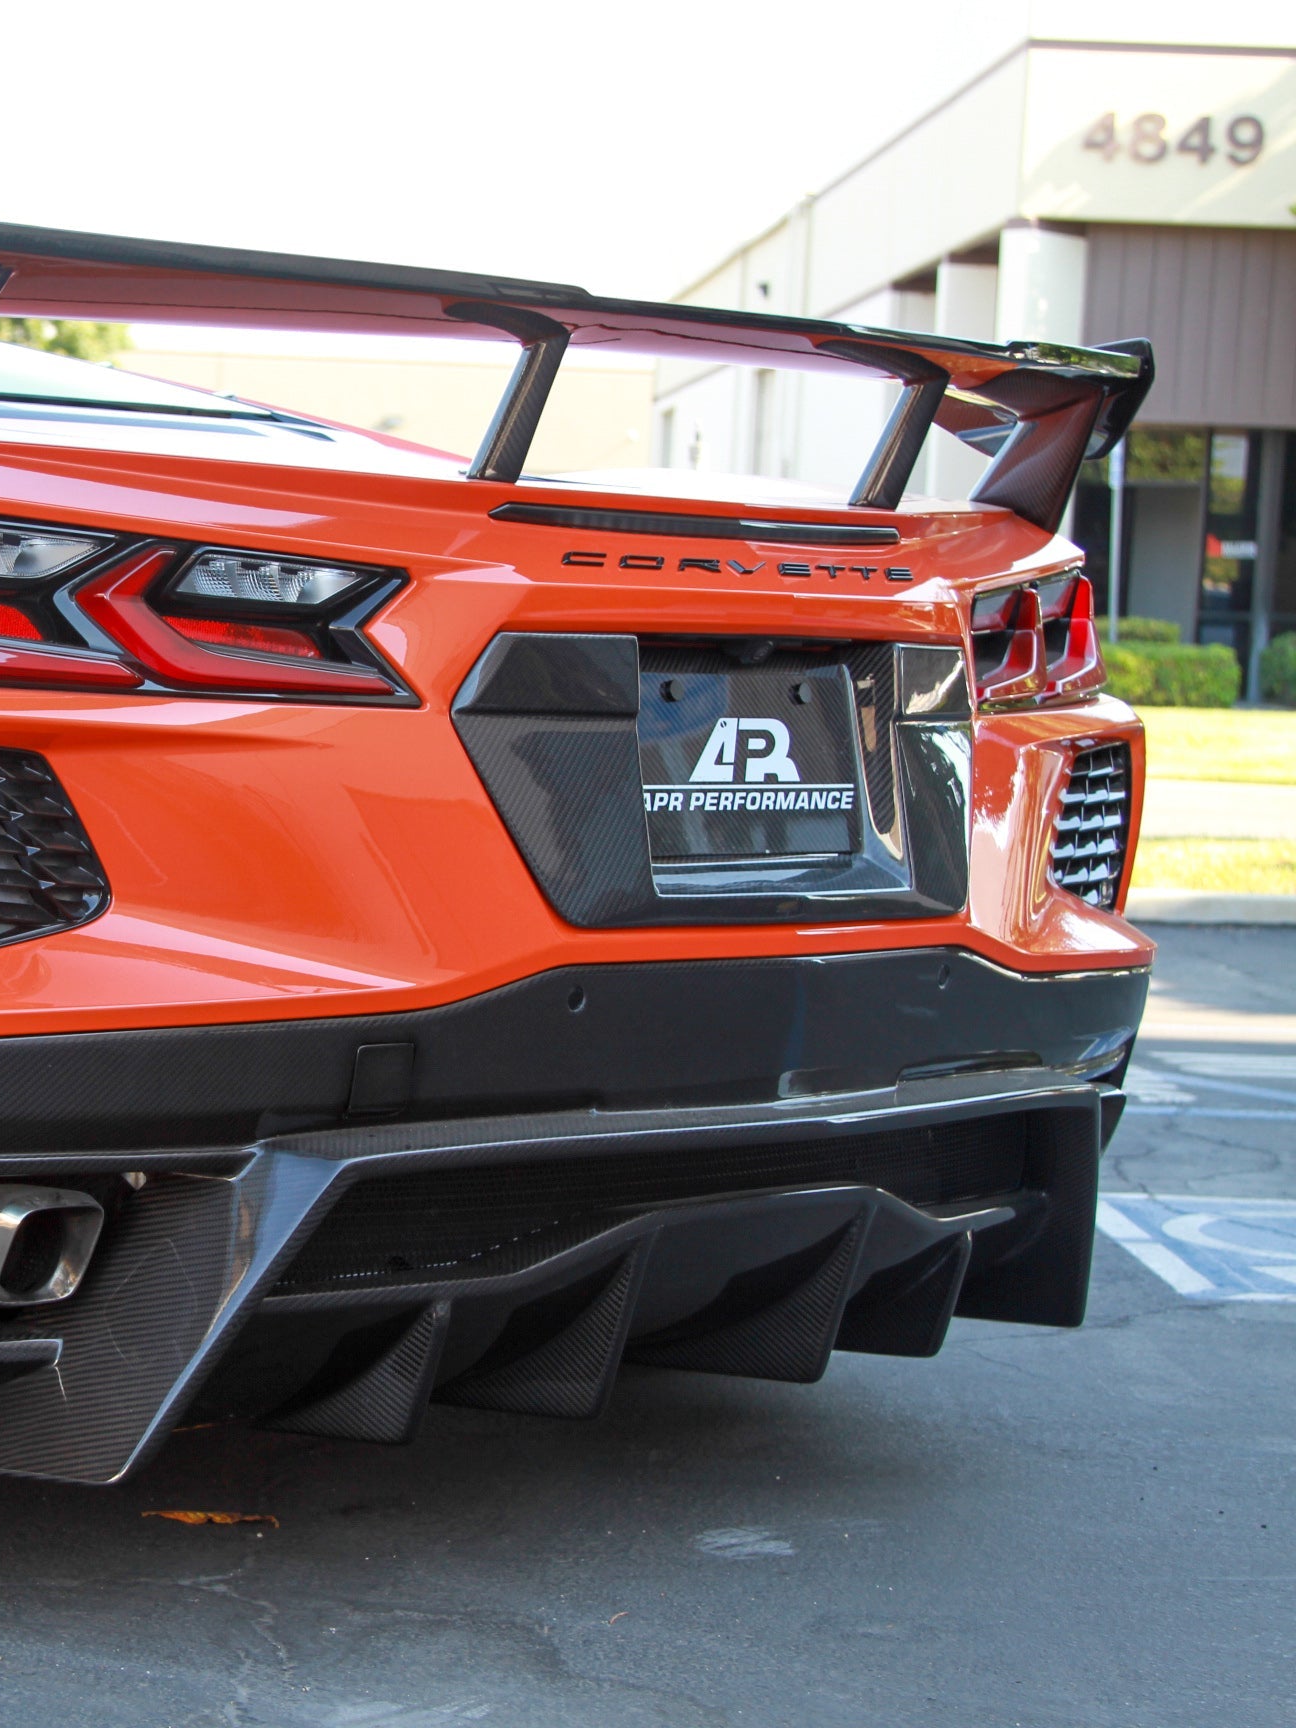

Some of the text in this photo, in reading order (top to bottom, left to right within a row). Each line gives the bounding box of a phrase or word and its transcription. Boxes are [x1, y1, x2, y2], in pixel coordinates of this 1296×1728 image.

[1082, 112, 1265, 166] 4849
[561, 551, 914, 581] CORVETTE
[643, 790, 854, 811] APR PERFORMANCE
